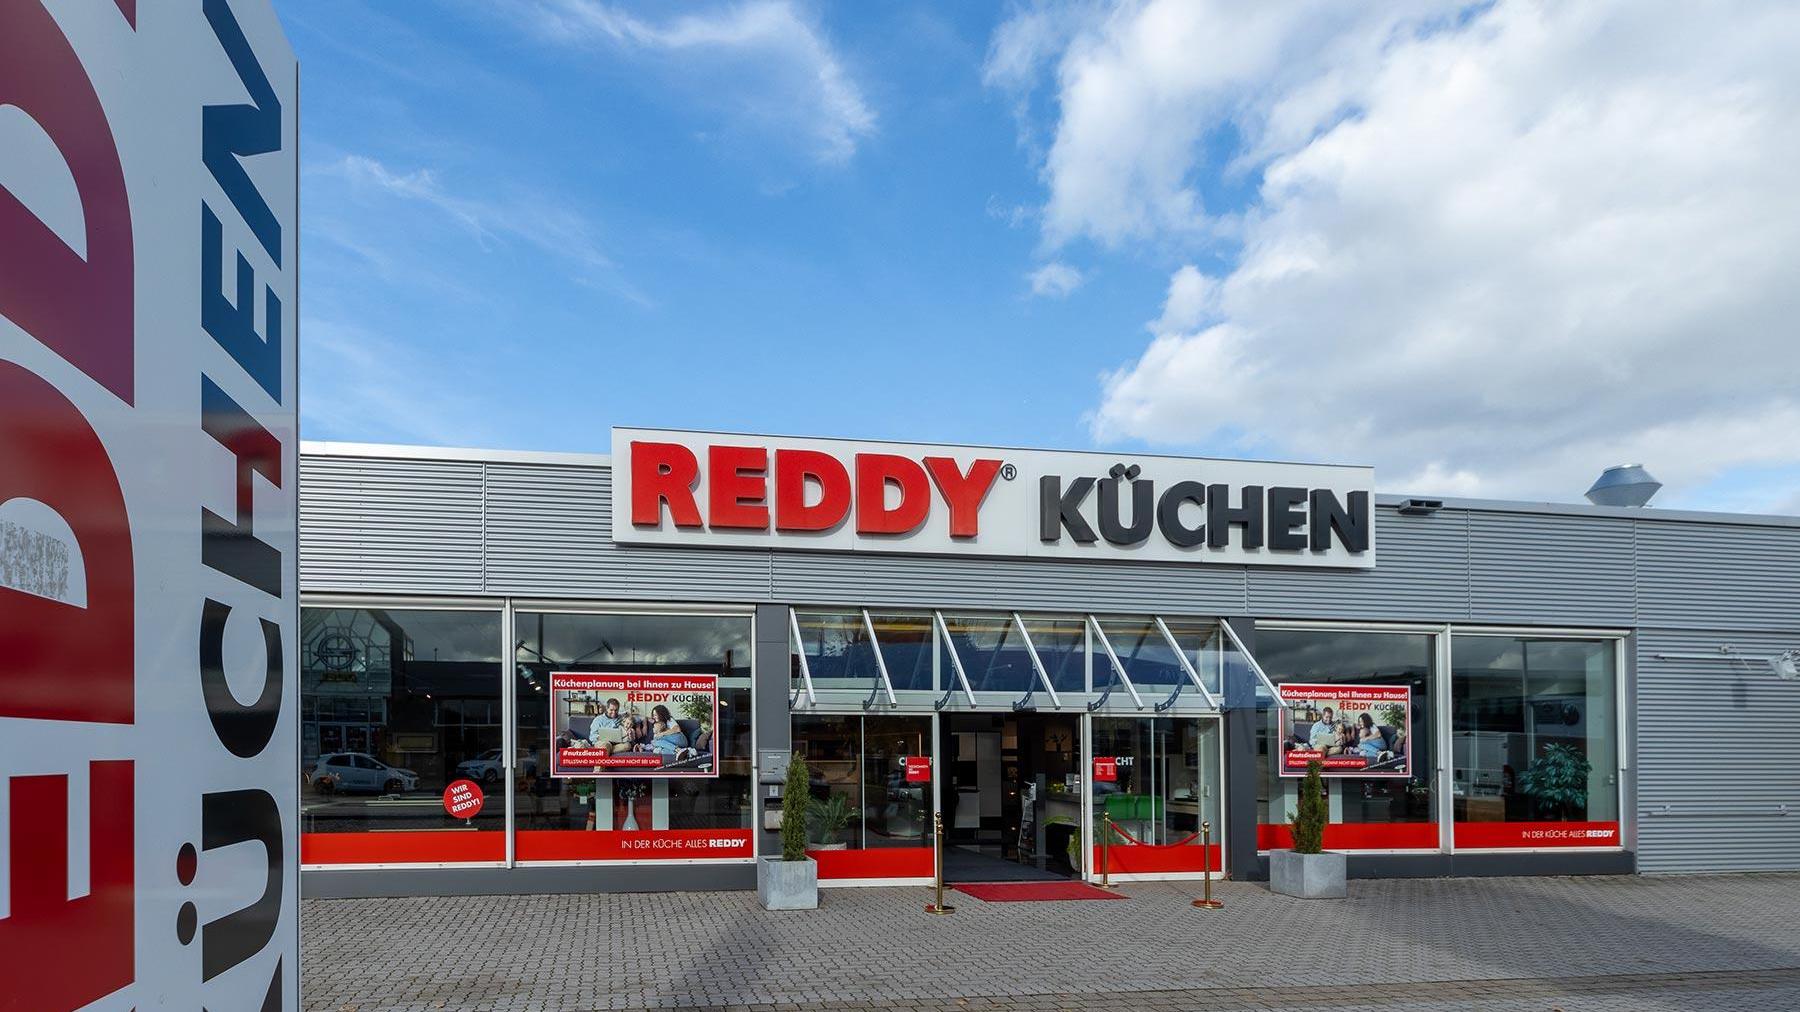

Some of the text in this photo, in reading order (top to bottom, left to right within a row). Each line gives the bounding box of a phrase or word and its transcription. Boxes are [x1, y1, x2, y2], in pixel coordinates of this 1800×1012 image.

[176, 0, 284, 1012] ÜCHEN
[1039, 463, 1369, 552] KÜCHEN
[554, 679, 624, 689] Küchenplanung
[627, 680, 640, 688] bei
[643, 680, 669, 688] Ihnen
[684, 681, 714, 689] Hause!
[628, 693, 711, 702] REDDY KÜCHEN
[1339, 702, 1371, 710] REDDY
[451, 784, 468, 794] WIR
[453, 792, 472, 803] SIND
[452, 798, 480, 812] REDDY!
[1586, 829, 1614, 838] REDDY
[621, 839, 746, 849] IN DER KÜCHE ALLES REDDY
